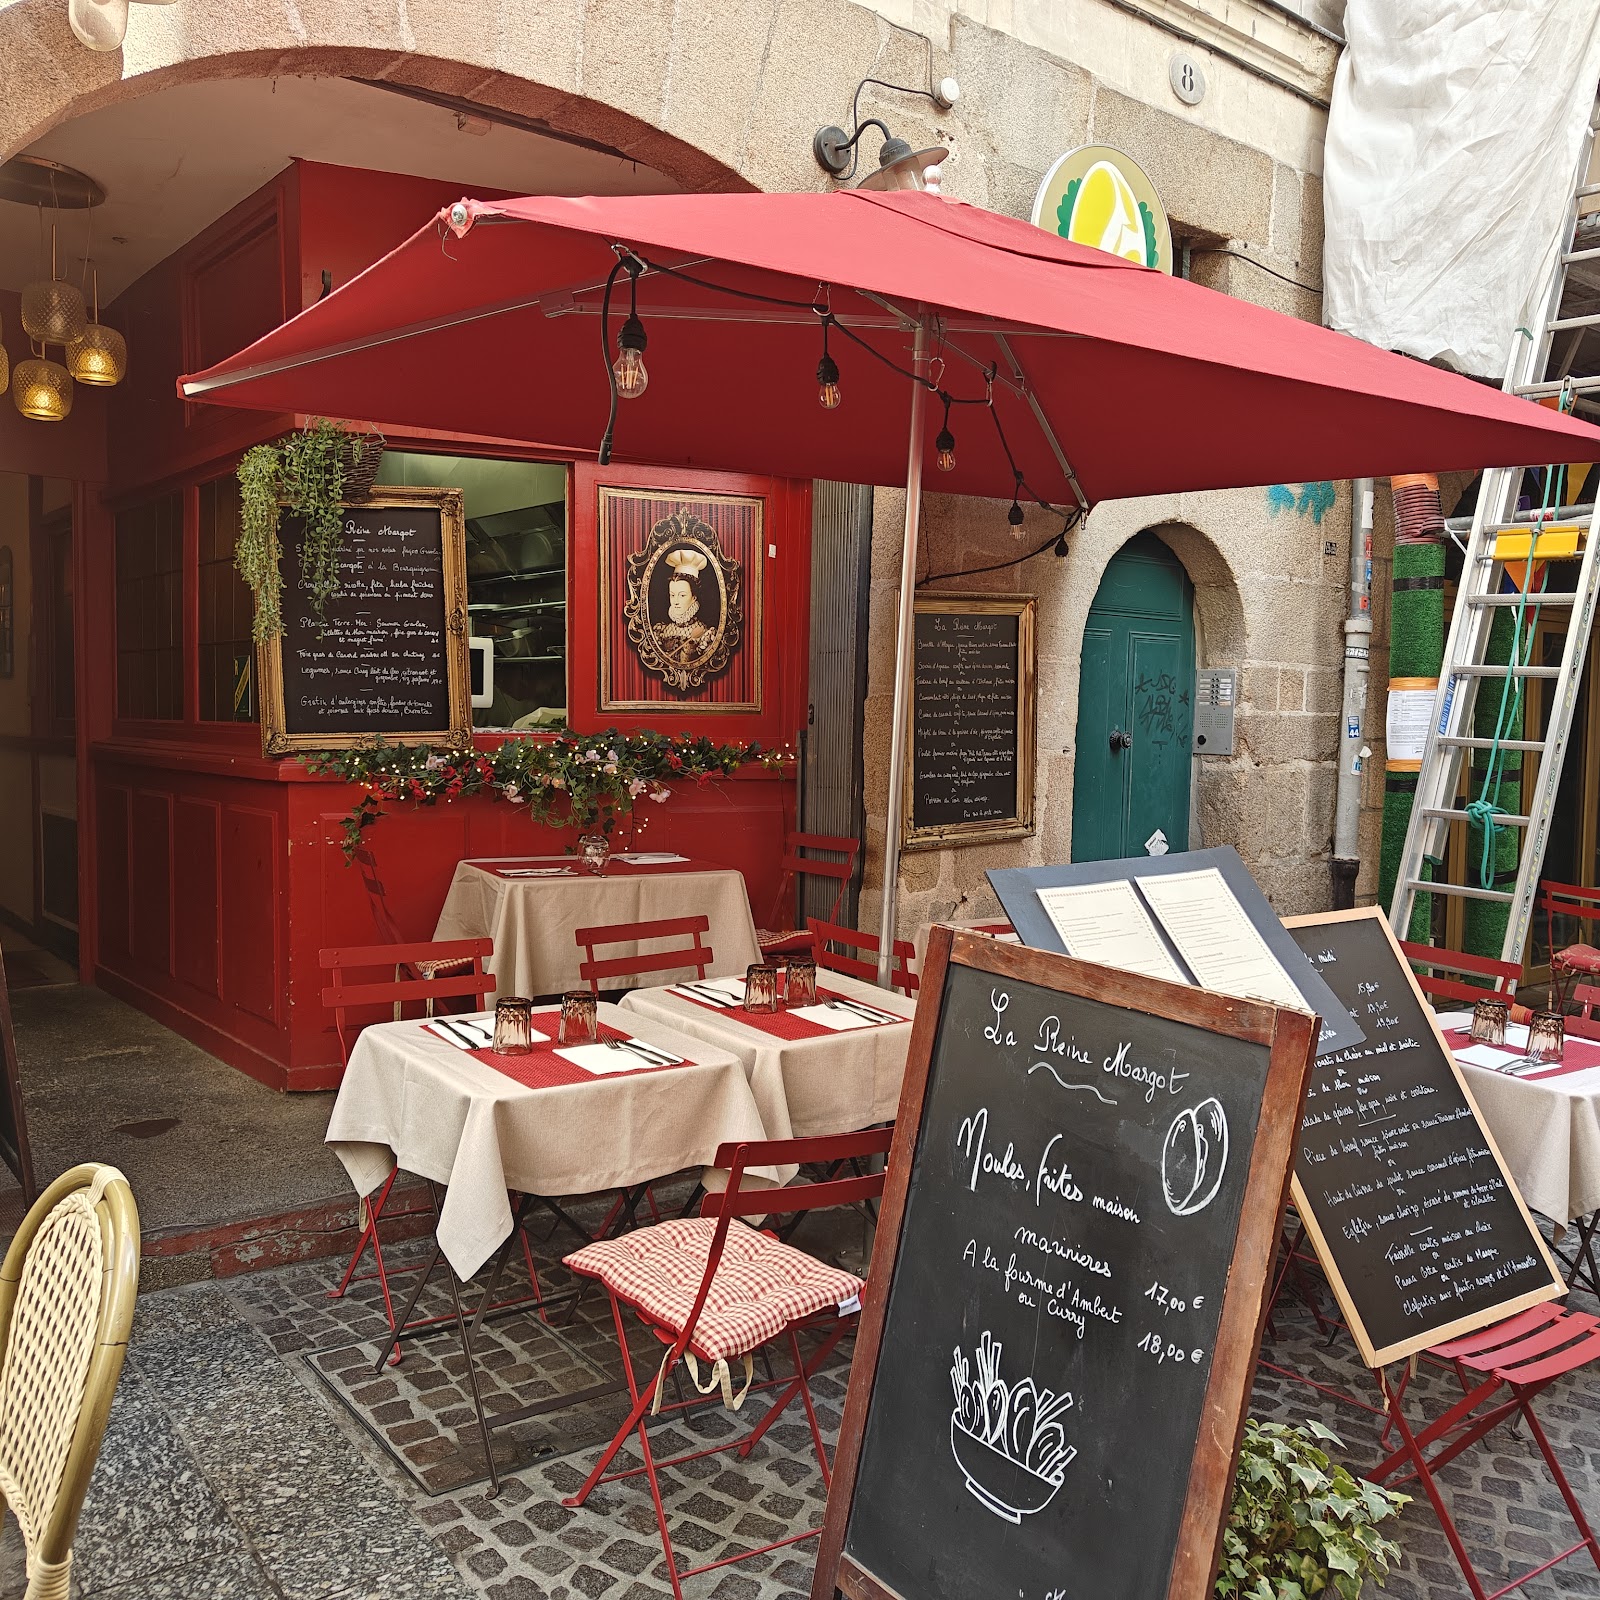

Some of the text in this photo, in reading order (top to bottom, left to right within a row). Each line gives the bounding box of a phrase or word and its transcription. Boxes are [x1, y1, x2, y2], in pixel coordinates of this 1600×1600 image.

[1181, 63, 1194, 92] 8
[345, 519, 417, 541] Reine Margot
[301, 695, 327, 706] Gratin
[1349, 728, 1359, 738] 44
[984, 987, 1191, 1103] La Reine Margot
[957, 1107, 1141, 1225] Moules, frites maison
[962, 1238, 978, 1268] A
[982, 1247, 1000, 1272] la
[1004, 1253, 1054, 1297] fourme
[1055, 1280, 1125, 1326] d'Ambert
[1017, 1290, 1087, 1340] ou Curry
